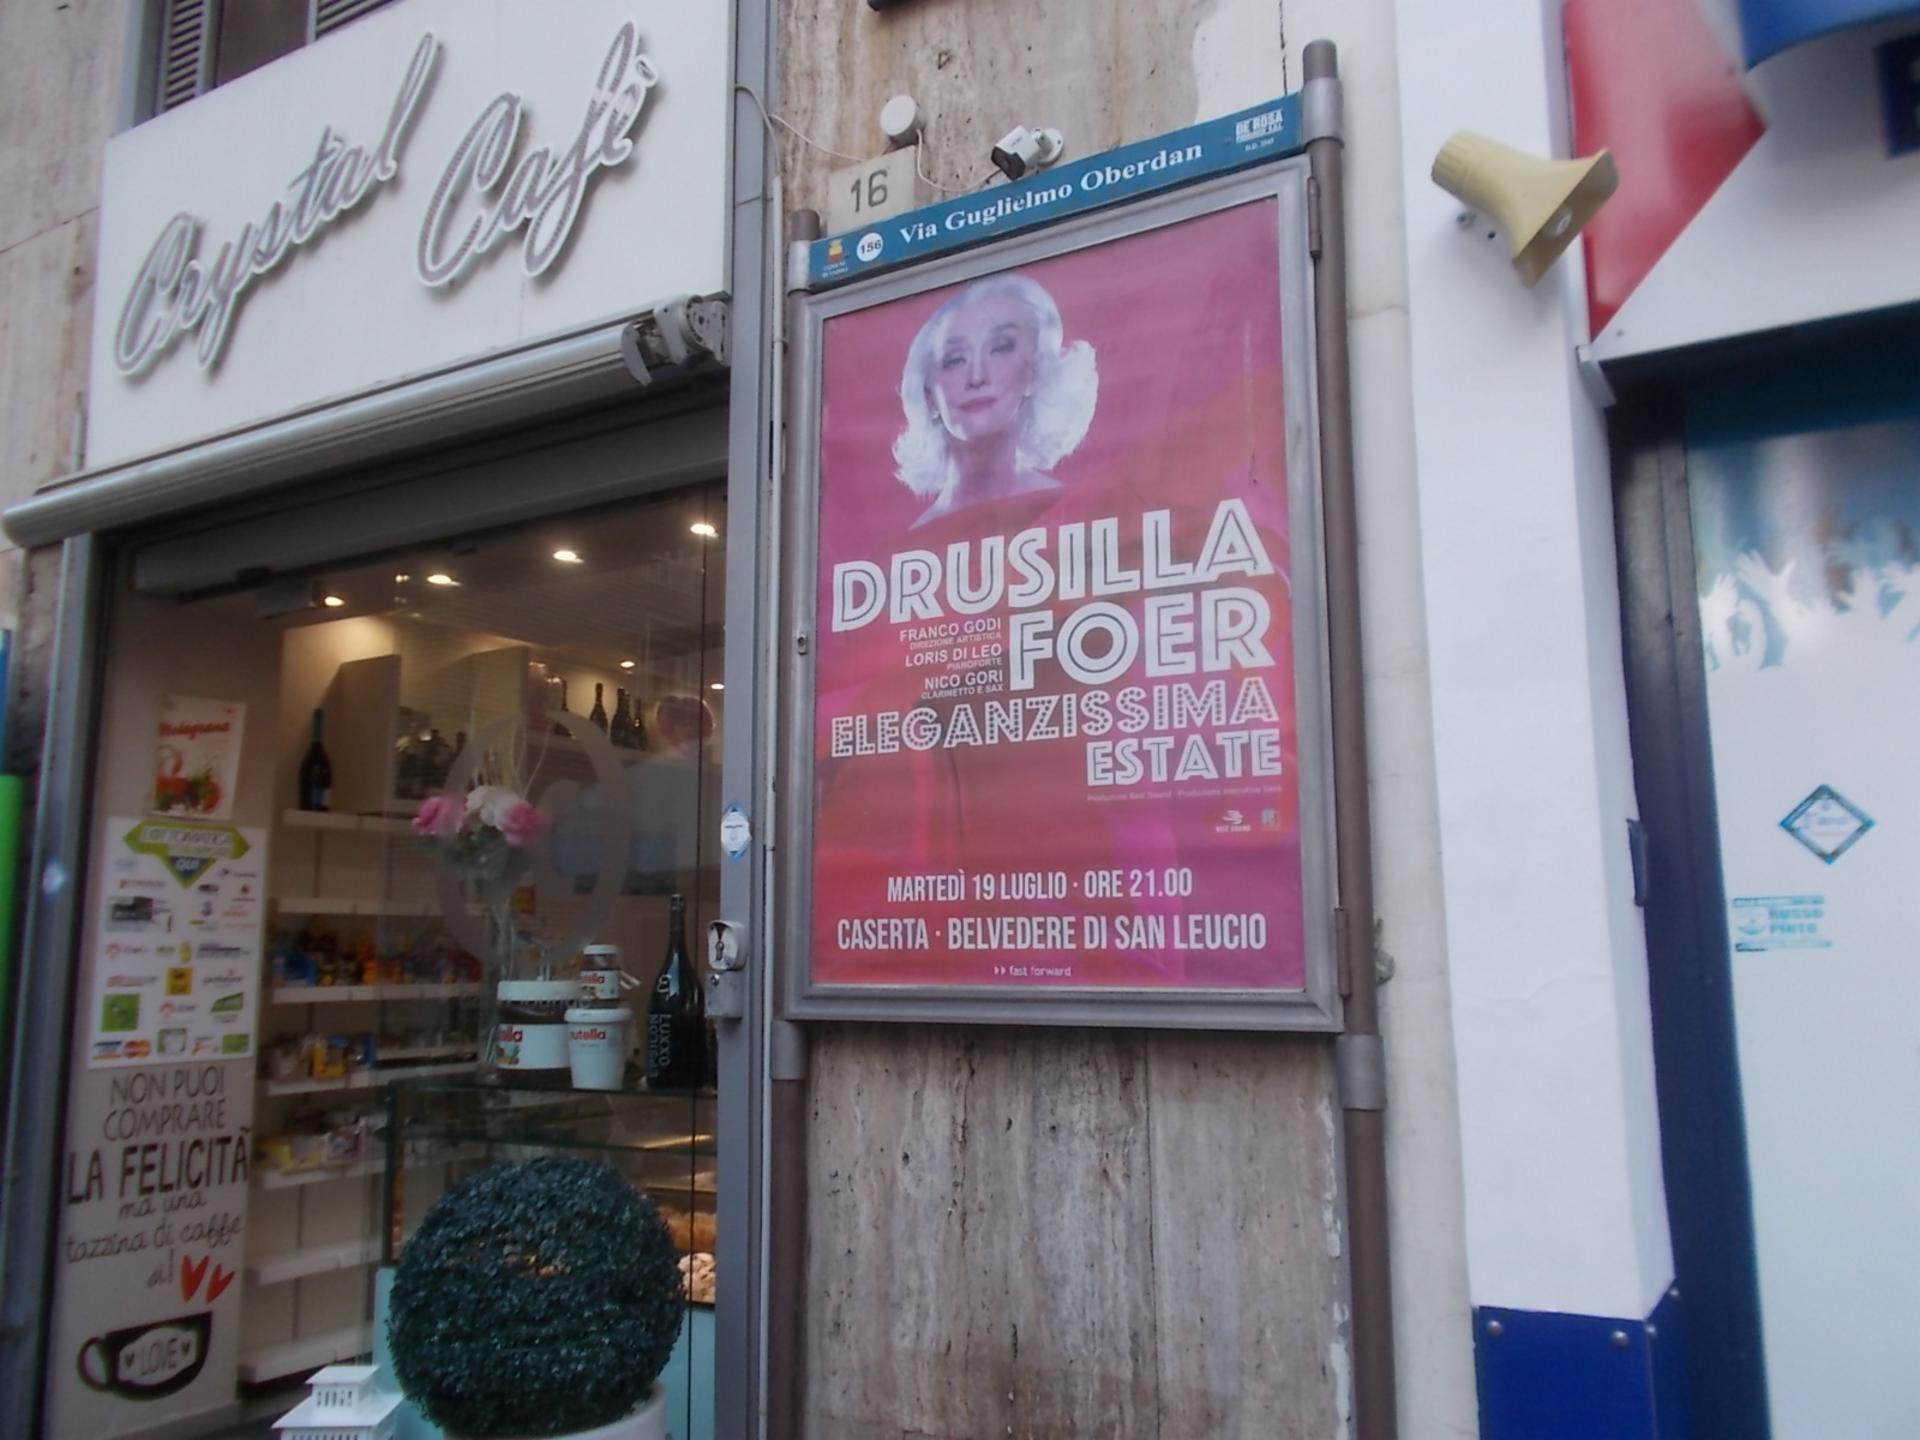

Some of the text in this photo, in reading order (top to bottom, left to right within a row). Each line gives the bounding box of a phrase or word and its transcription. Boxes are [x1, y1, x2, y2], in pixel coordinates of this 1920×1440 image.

[115, 30, 438, 376] Crystal
[850, 169, 888, 213] 16
[899, 143, 1202, 245] Via Guglielmo Oberdan
[860, 240, 881, 255] 156
[831, 498, 1275, 632] DRUSILLA
[900, 617, 1002, 642] FRANCO GODI
[910, 631, 1002, 650] DIREZIONE ARTISTICA
[1008, 586, 1276, 691] FOER
[905, 643, 1002, 667] LORIS DI LEO
[946, 657, 1003, 670] PIANOFORTE
[920, 683, 1004, 700] CLARINETTO E SAX
[924, 669, 1003, 691] NICO GORI
[830, 677, 1280, 758] ELEGANZISSIMA
[1086, 728, 1282, 786] ESTATE
[887, 867, 1193, 903] MARTEDÌ 19 LUGLIO ORE 21.00
[837, 912, 1267, 950] CASERTA BELVEDERE DI SAN LEUCIO
[1009, 965, 1072, 977] fast forward
[110, 1066, 225, 1106] NON PUOI
[103, 1097, 227, 1143] COMPRARE
[66, 1148, 105, 1205] LA
[117, 1189, 208, 1221] ma una
[65, 1231, 148, 1264] tazzina
[153, 1216, 175, 1250] di
[146, 1248, 175, 1289] al
[140, 1337, 178, 1377] LOVE
